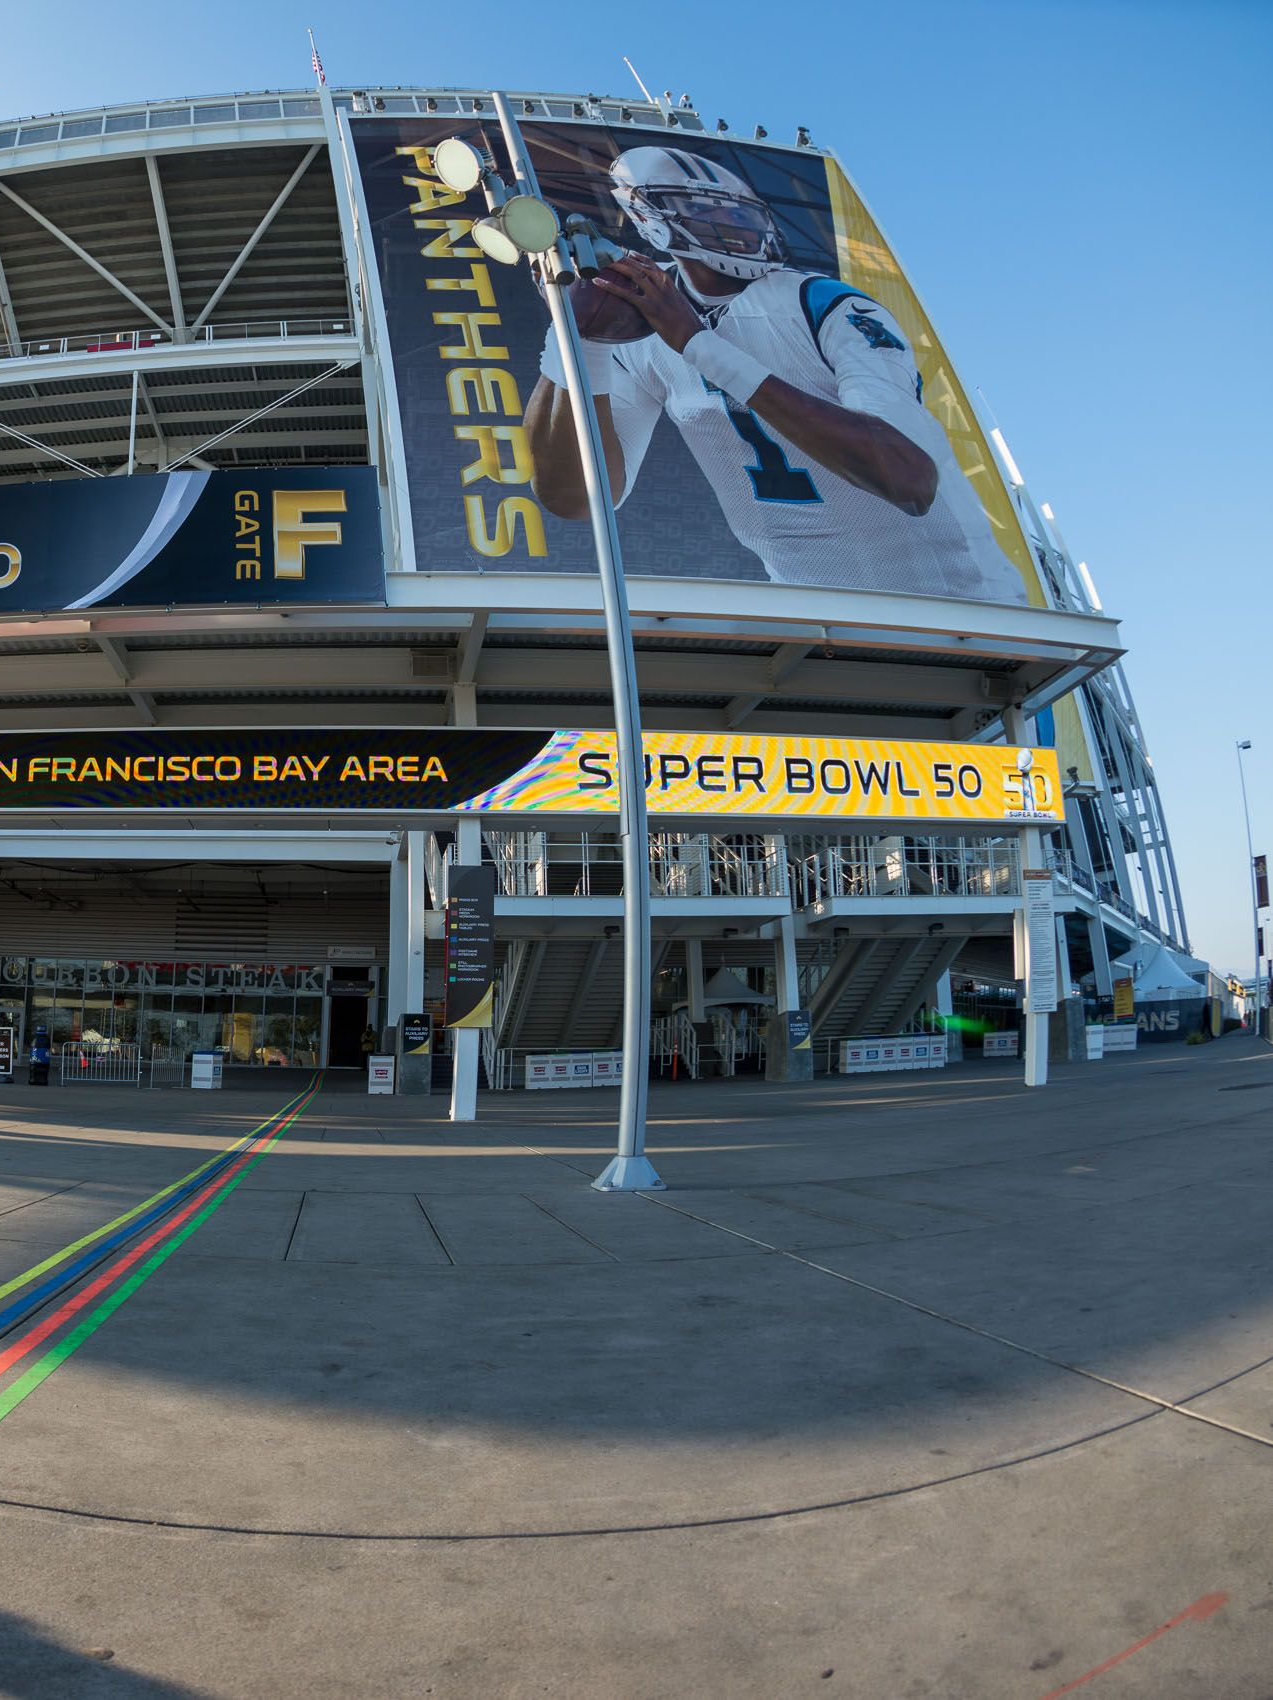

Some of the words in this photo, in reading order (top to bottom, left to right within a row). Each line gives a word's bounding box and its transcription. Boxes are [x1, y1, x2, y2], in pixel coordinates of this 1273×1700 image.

[395, 146, 549, 557] PANTHERS
[235, 490, 260, 580] GATE
[272, 489, 347, 580] F
[28, 755, 242, 783] FRANCISCO
[253, 755, 331, 782] BAY
[339, 756, 449, 782] AREA
[784, 756, 920, 797] BOWL
[934, 763, 983, 798] 50
[186, 966, 324, 992] STEAK
